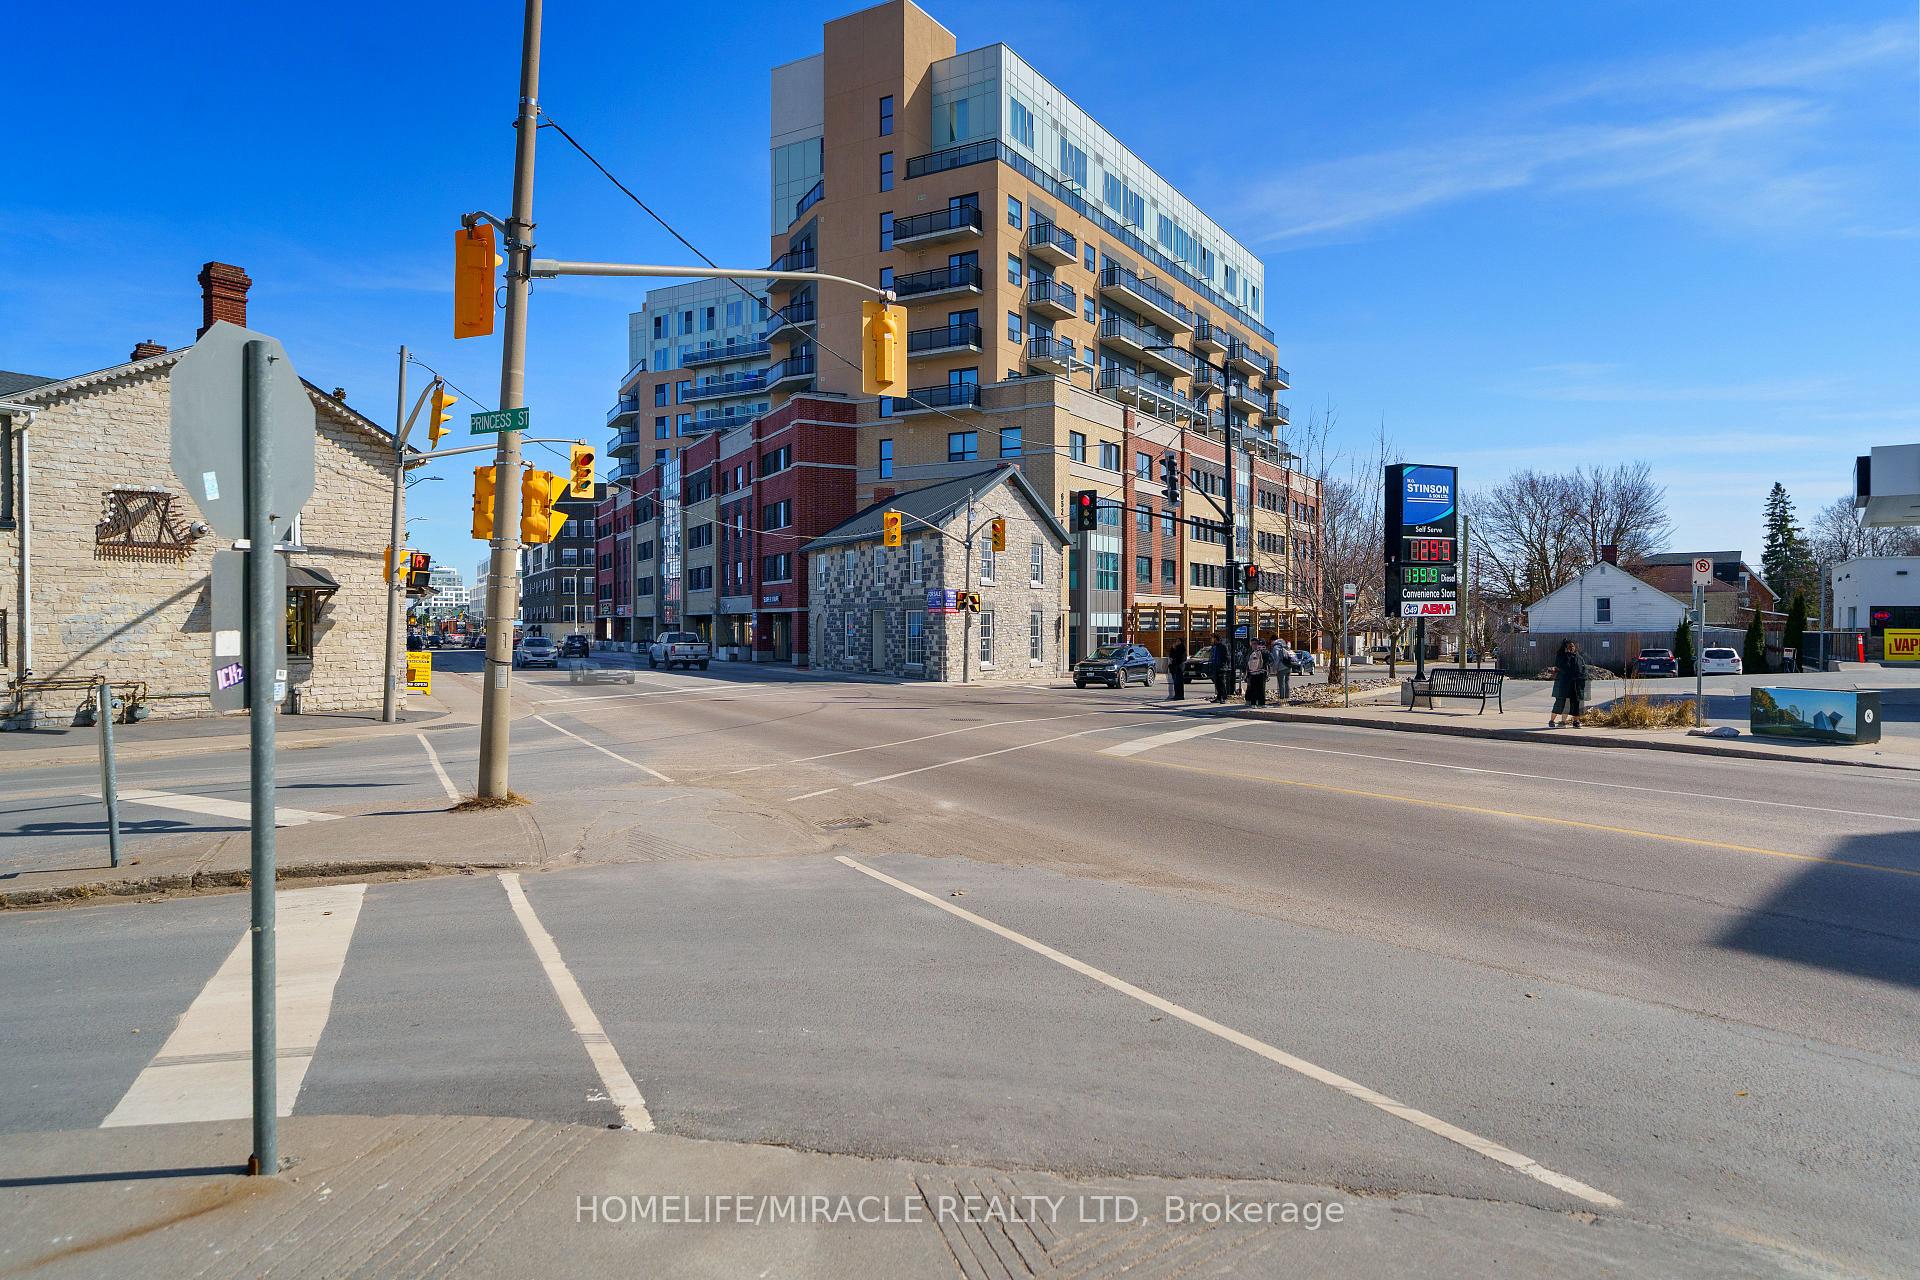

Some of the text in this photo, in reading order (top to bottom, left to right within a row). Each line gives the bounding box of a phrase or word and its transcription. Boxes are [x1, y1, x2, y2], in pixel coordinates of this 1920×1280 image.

[471, 410, 529, 431] PRINCESS ST
[1407, 483, 1449, 494] STINSON
[1415, 525, 1426, 533] Self
[1440, 574, 1456, 583] Diesel
[1402, 588, 1456, 599] Convenience Store
[1421, 603, 1451, 615] ABM
[1893, 638, 1920, 652] VAP
